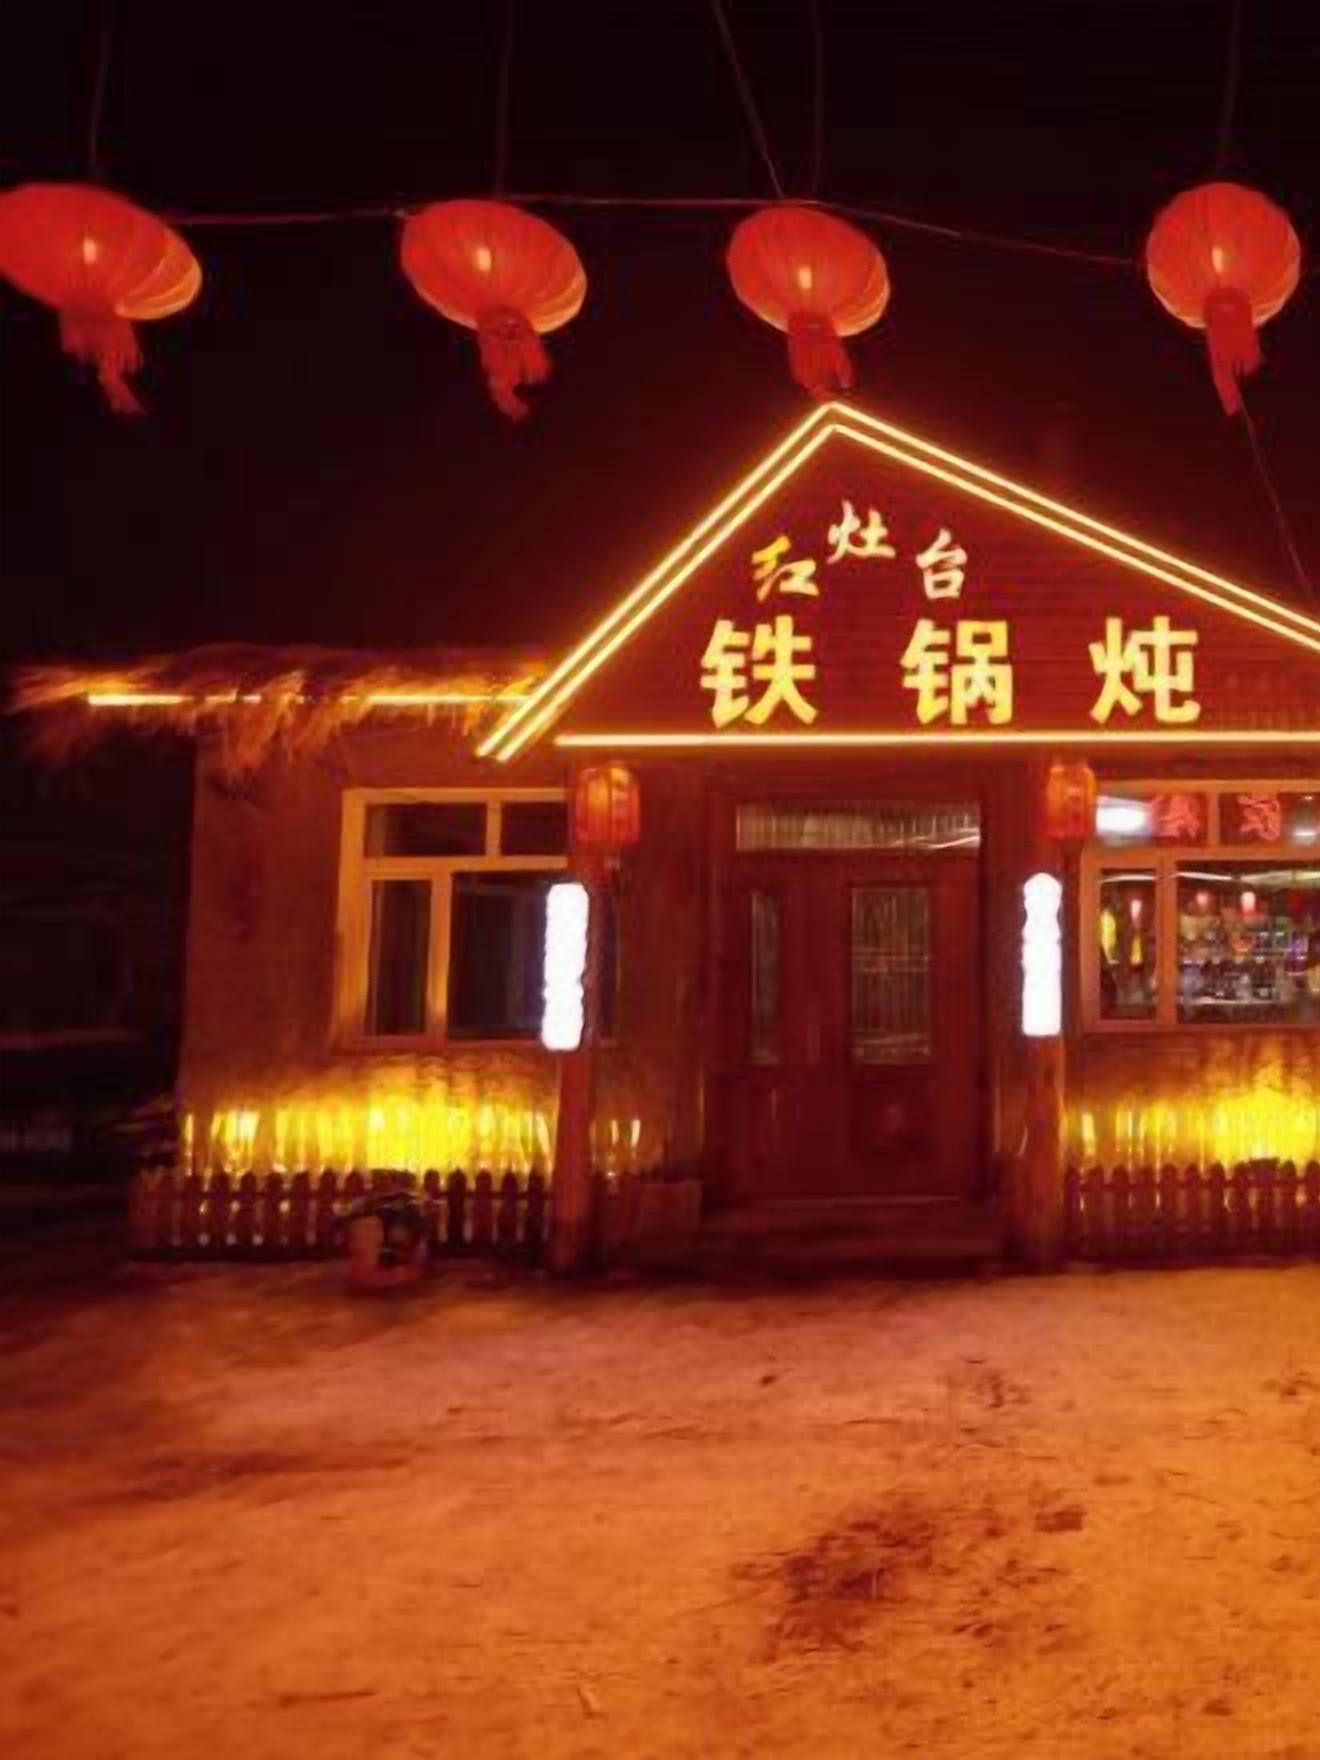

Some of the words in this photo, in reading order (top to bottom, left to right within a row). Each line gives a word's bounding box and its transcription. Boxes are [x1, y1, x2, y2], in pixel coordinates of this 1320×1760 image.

[752, 501, 968, 601] 红灶台
[700, 614, 1201, 728] 铁锅炖
